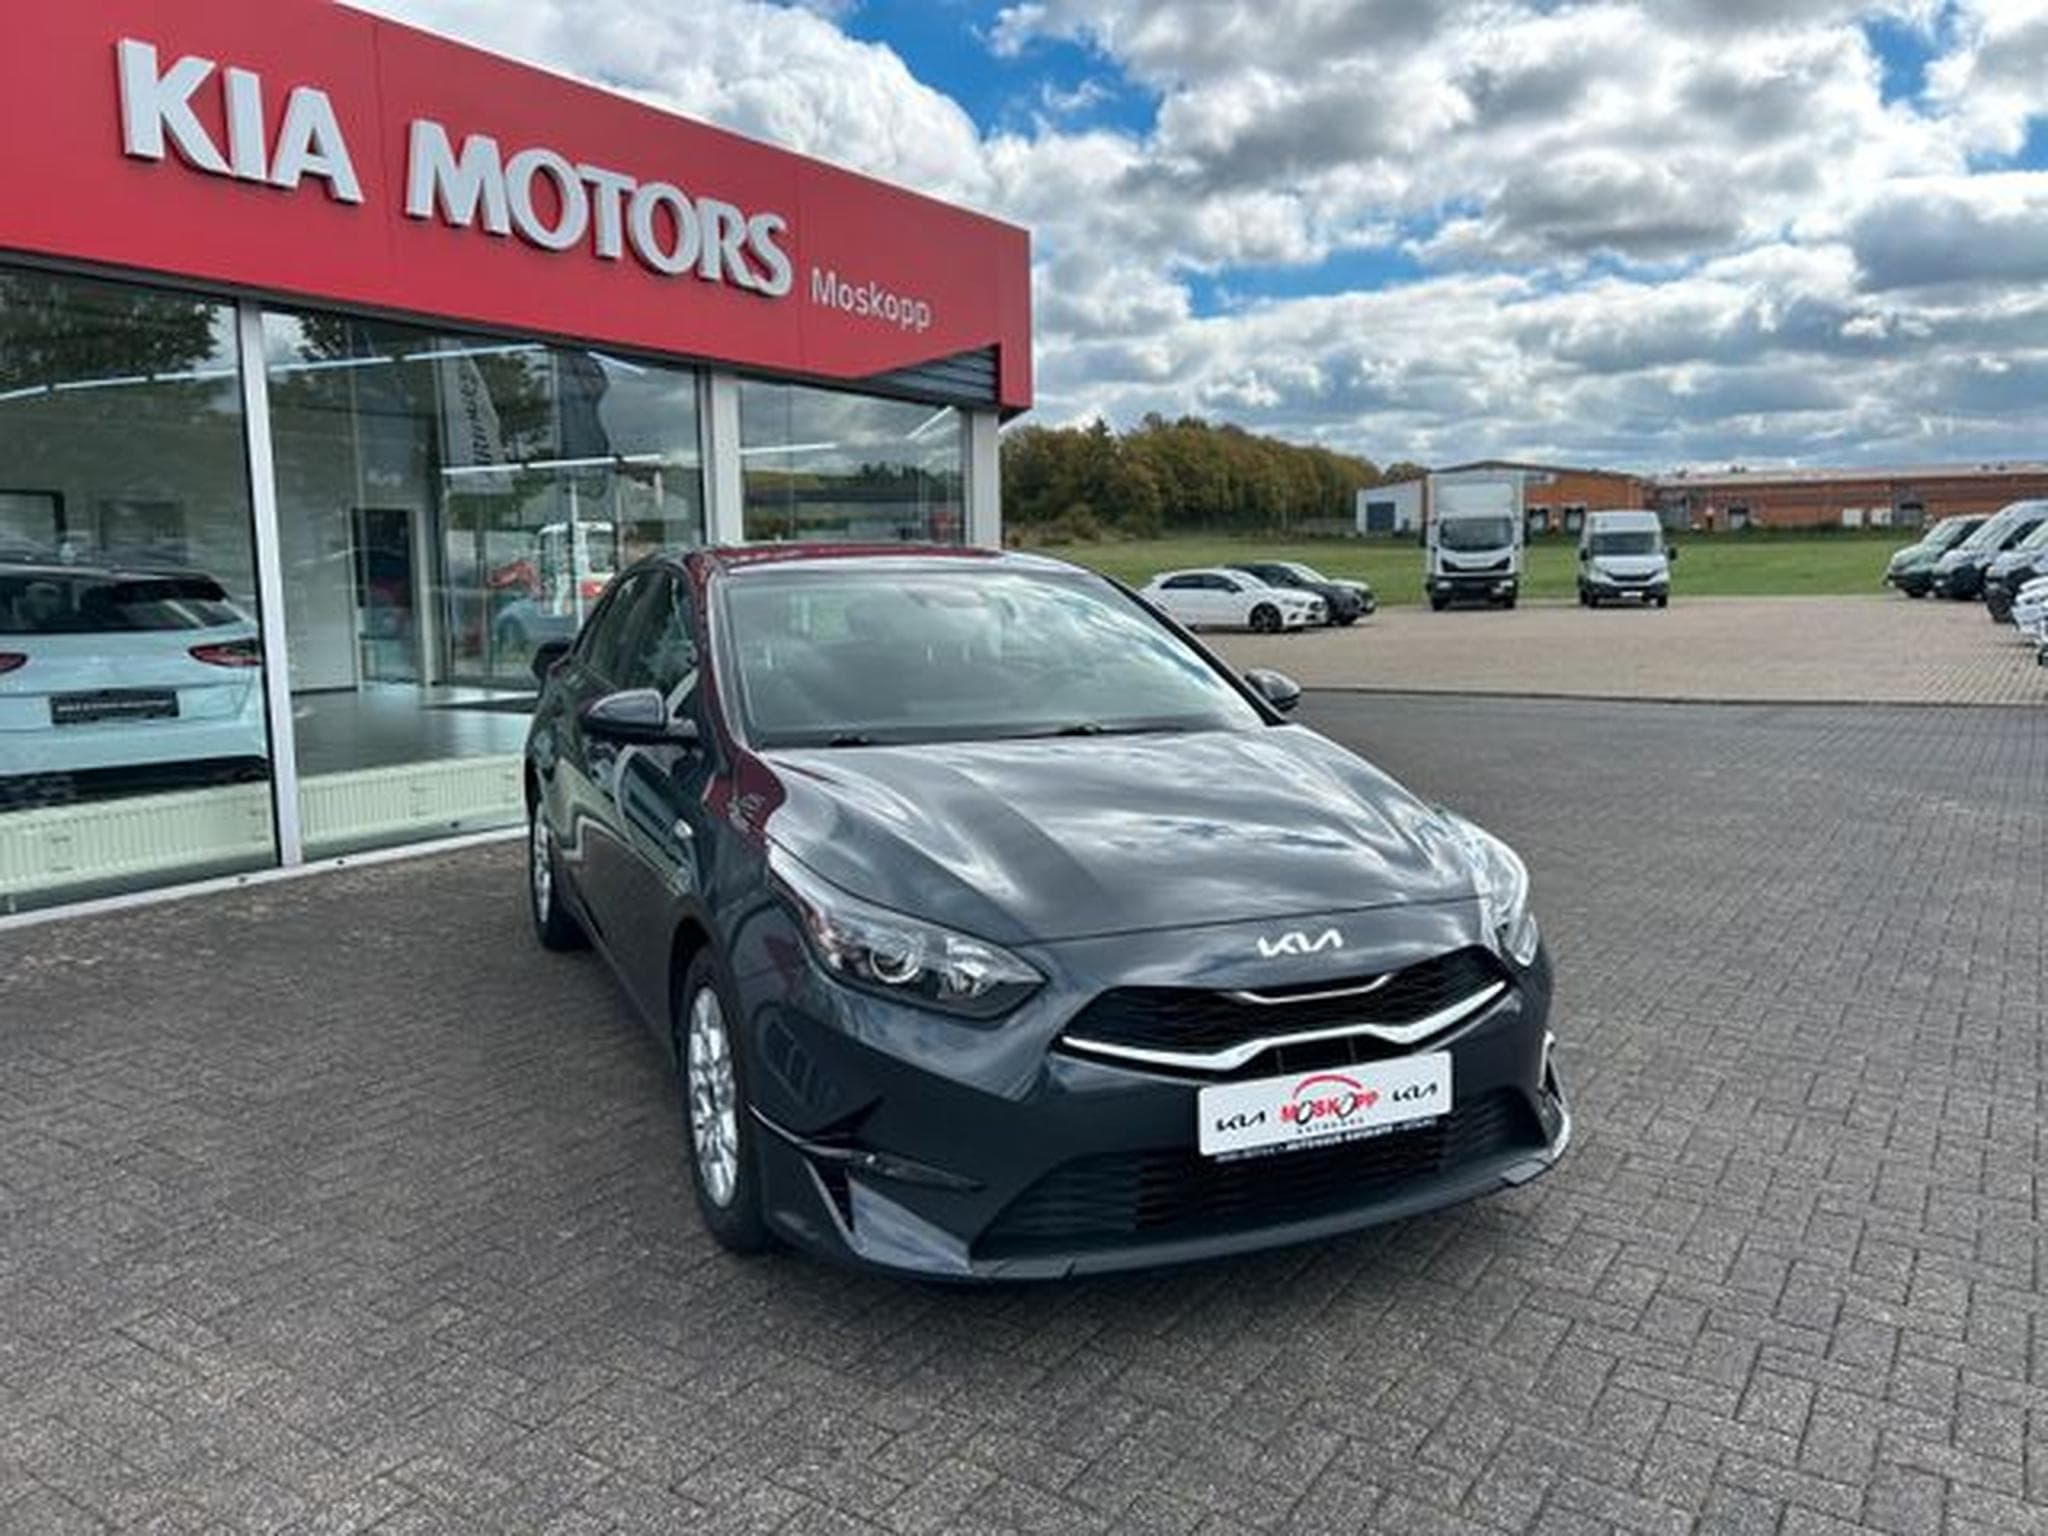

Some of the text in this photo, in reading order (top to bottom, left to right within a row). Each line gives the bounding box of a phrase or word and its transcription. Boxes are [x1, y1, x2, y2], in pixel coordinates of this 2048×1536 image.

[116, 37, 793, 298] KIA MOTORS
[811, 267, 931, 333] Moskopp
[1257, 929, 1343, 957] KIA
[1216, 1082, 1438, 1132] KIA MOSKOPP KIA
